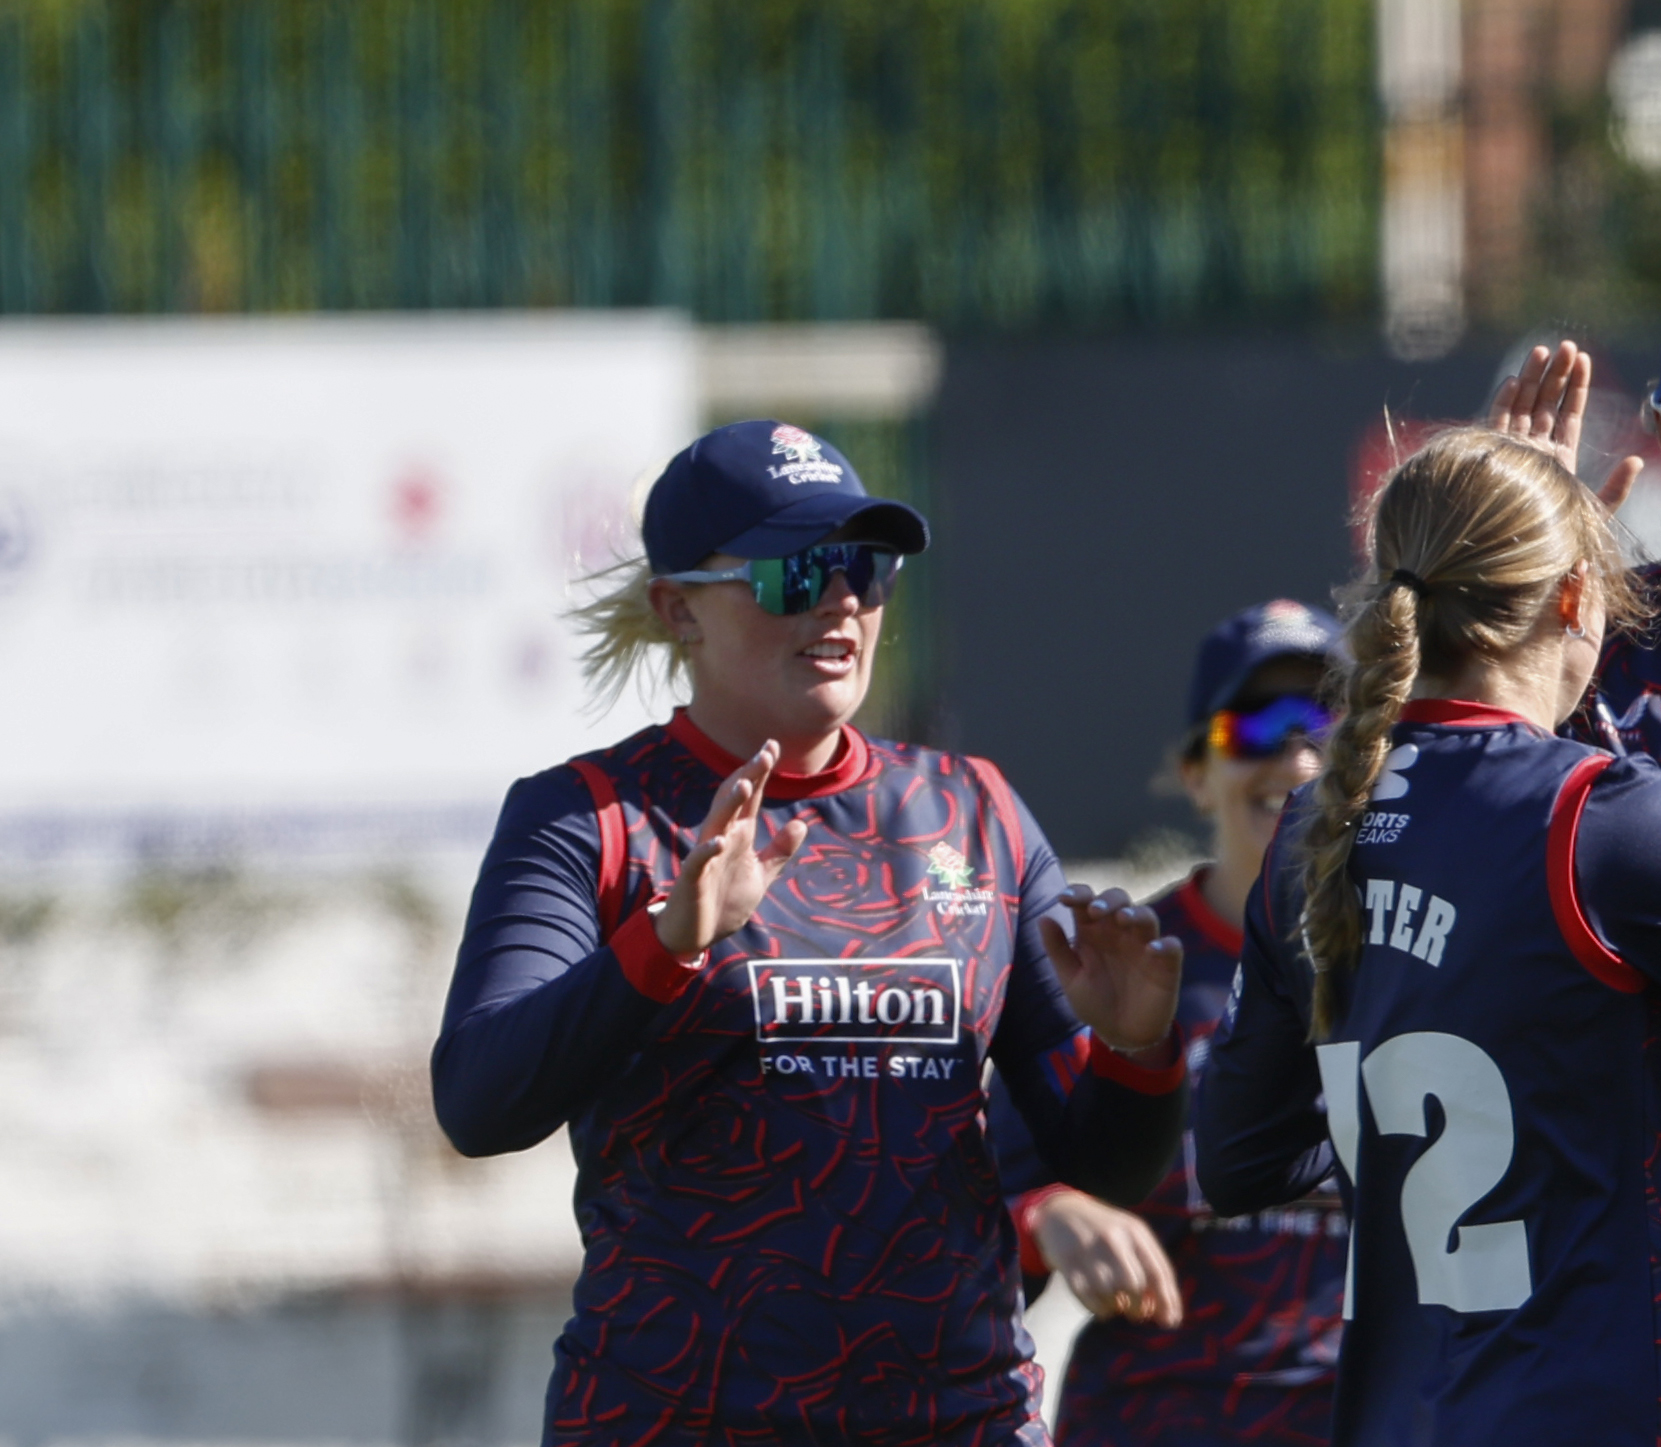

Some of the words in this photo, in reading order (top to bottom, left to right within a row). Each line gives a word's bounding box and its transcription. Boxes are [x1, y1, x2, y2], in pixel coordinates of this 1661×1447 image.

[1361, 811, 1411, 829] ORTS
[1355, 828, 1402, 844] EAKS
[1358, 878, 1457, 968] TER
[769, 976, 945, 1025] Hilton
[759, 1054, 815, 1074] FOR
[821, 1056, 879, 1078] THE
[888, 1056, 955, 1079] STAY
